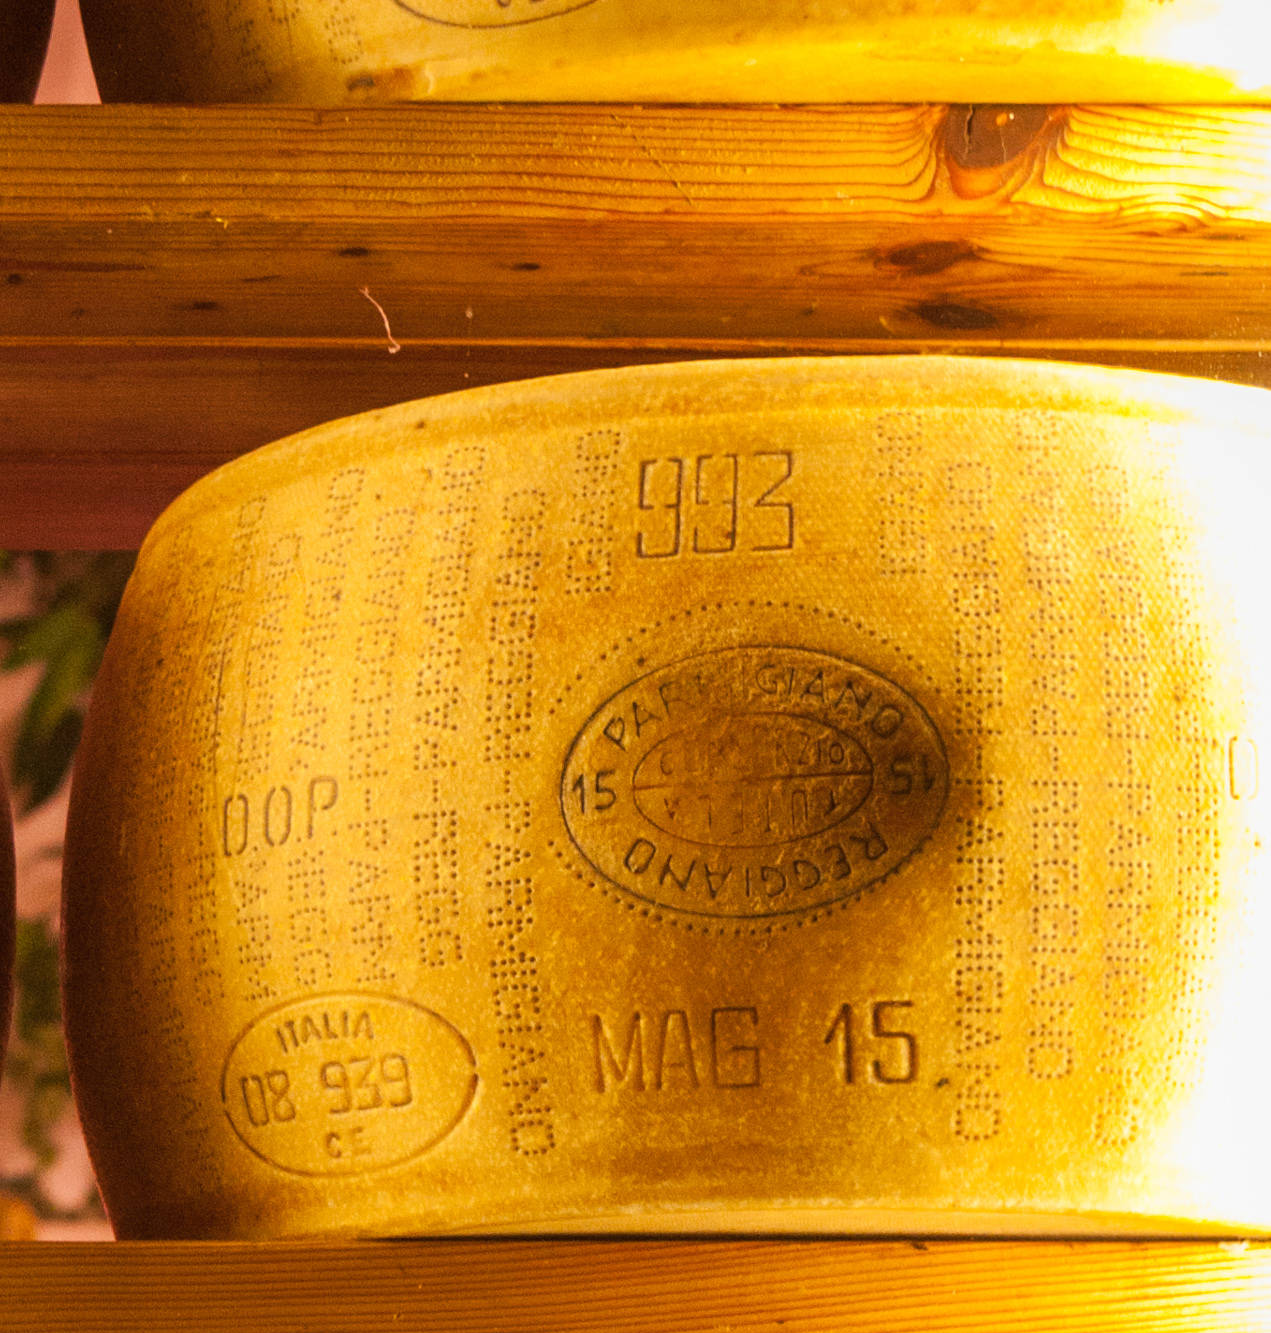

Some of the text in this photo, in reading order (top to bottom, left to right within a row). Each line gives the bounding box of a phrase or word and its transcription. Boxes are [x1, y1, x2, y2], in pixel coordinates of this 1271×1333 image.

[636, 450, 795, 558] 993
[603, 662, 904, 752] PARGIANO
[571, 770, 617, 814] 15
[277, 1010, 375, 1053] ITALIA
[591, 1000, 918, 1093] MAG 15
[241, 1054, 414, 1128] 08 939
